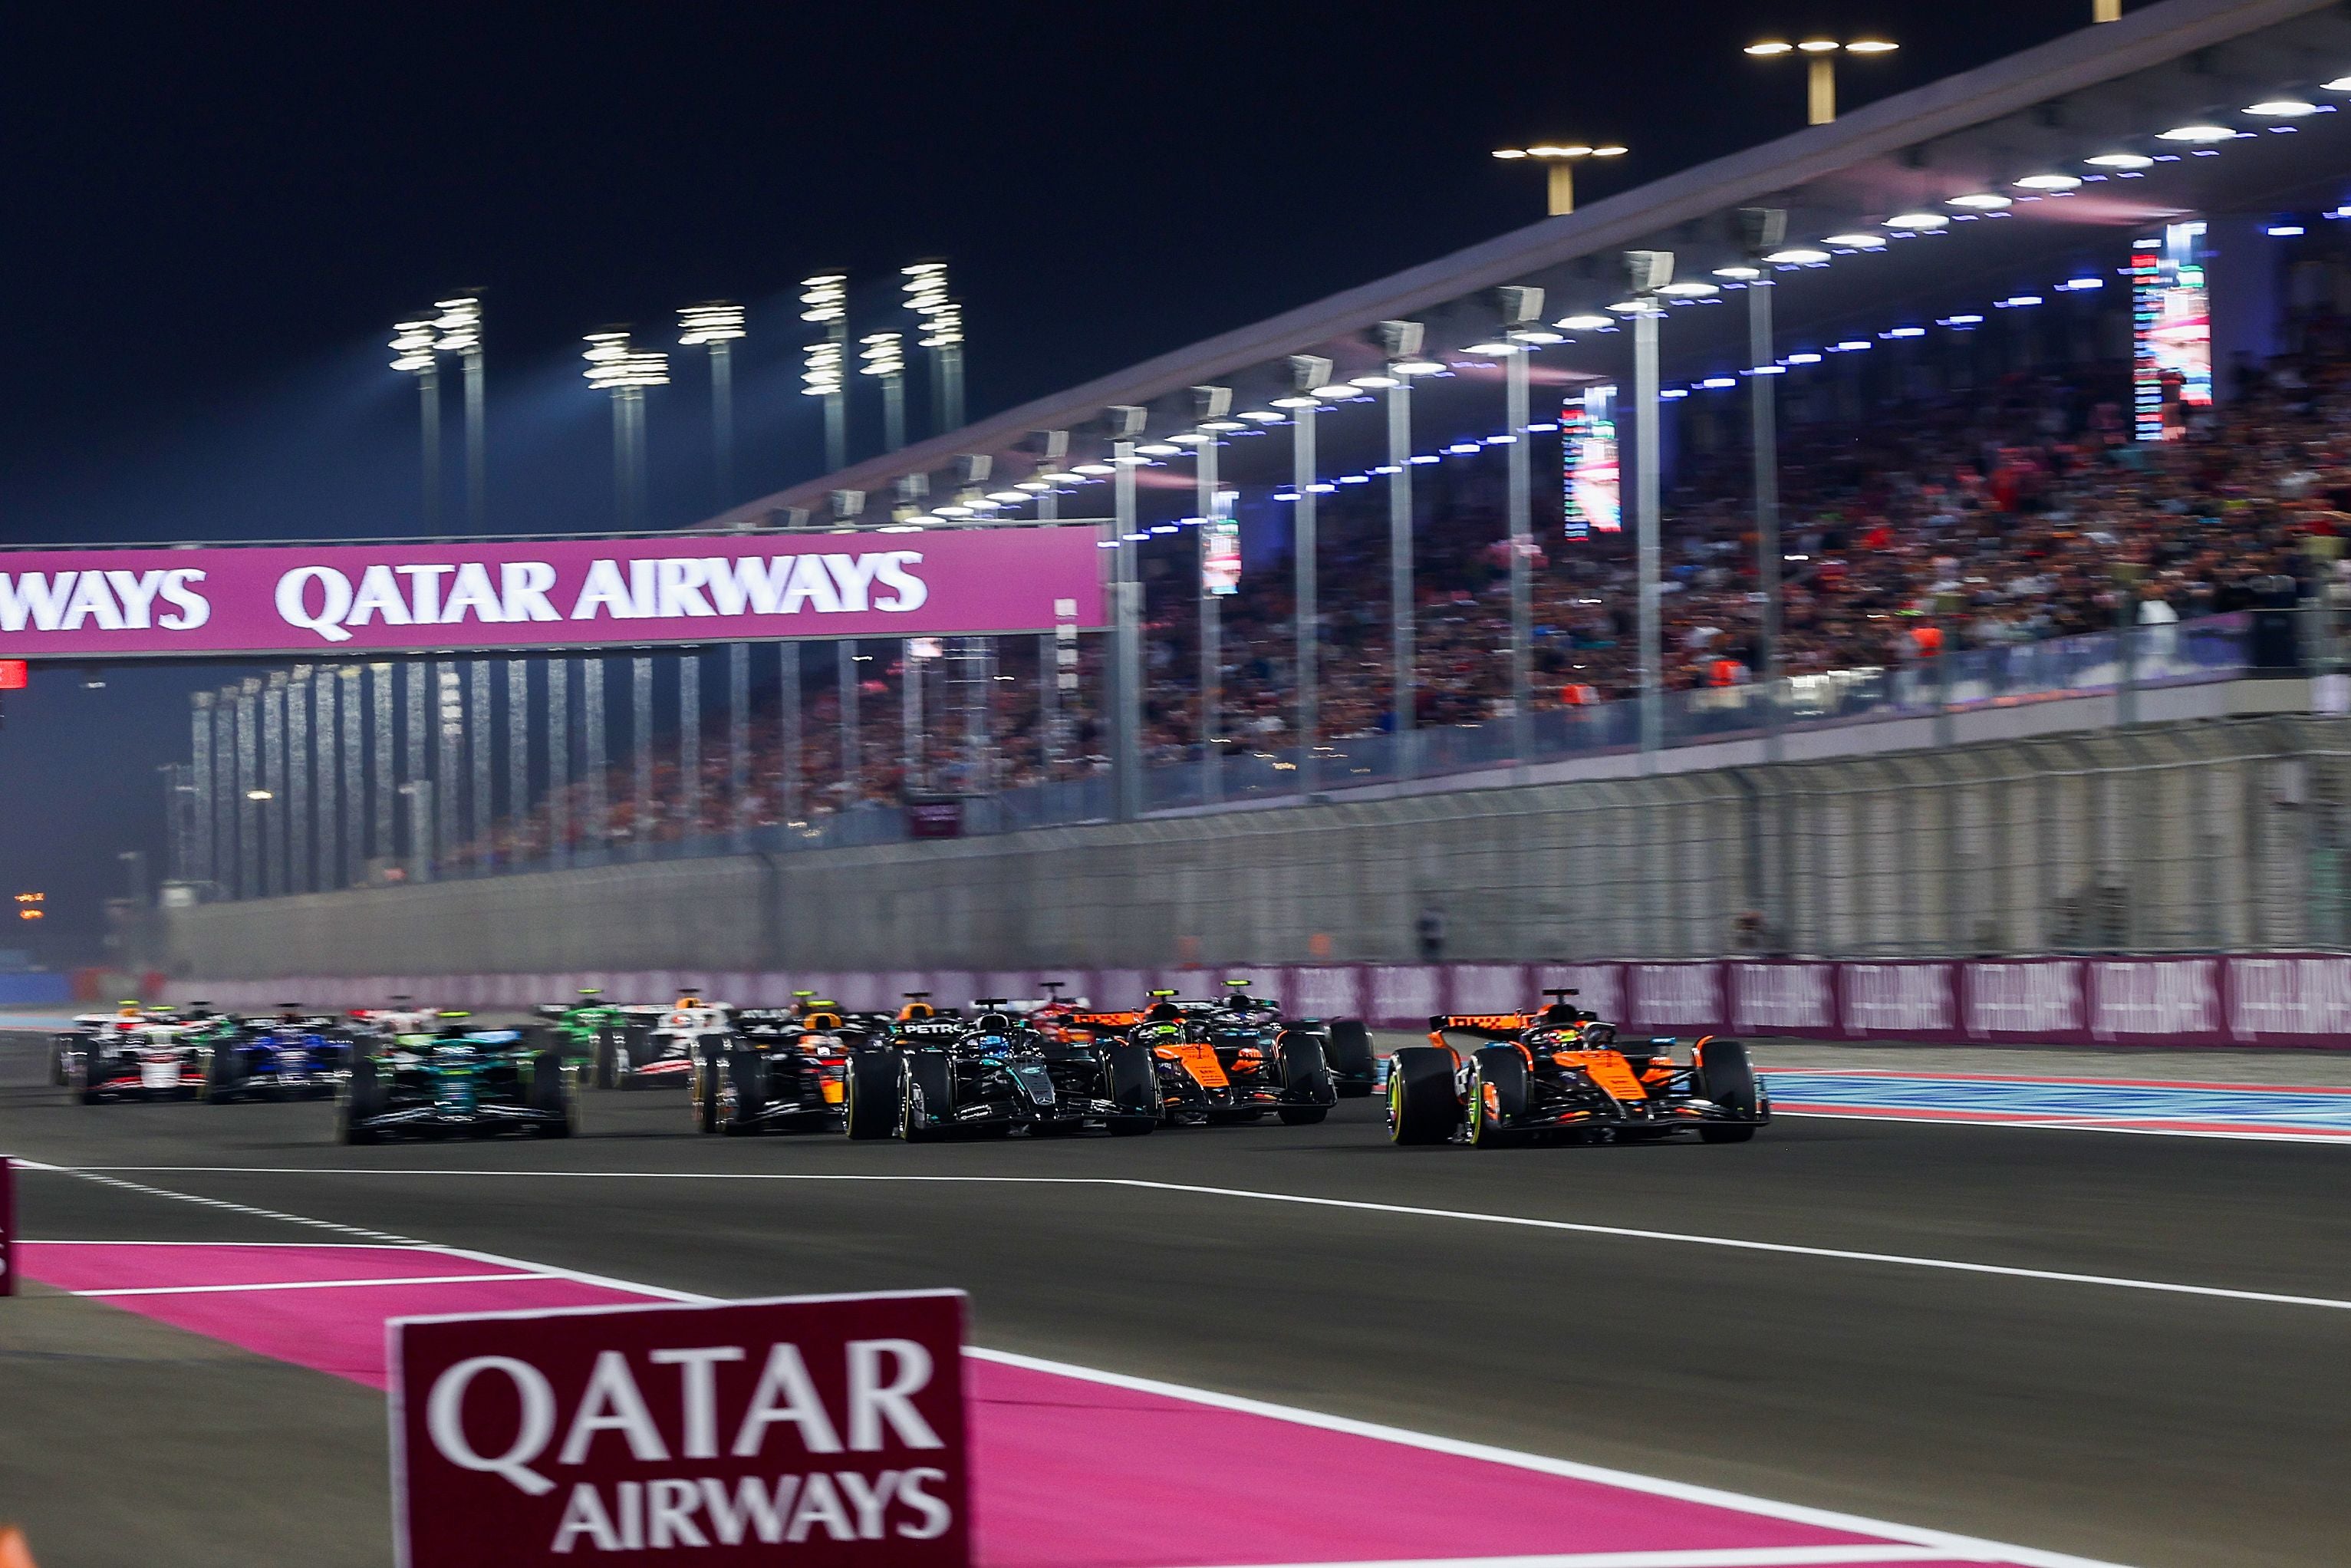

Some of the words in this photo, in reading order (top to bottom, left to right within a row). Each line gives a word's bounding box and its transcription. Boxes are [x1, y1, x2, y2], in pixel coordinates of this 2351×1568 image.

[275, 562, 562, 641] QATAR
[570, 551, 928, 620] AIRWAYS
[904, 1023, 966, 1034] PETRO
[426, 1337, 946, 1496] QATAR
[550, 1467, 953, 1554] AIRWAYS
